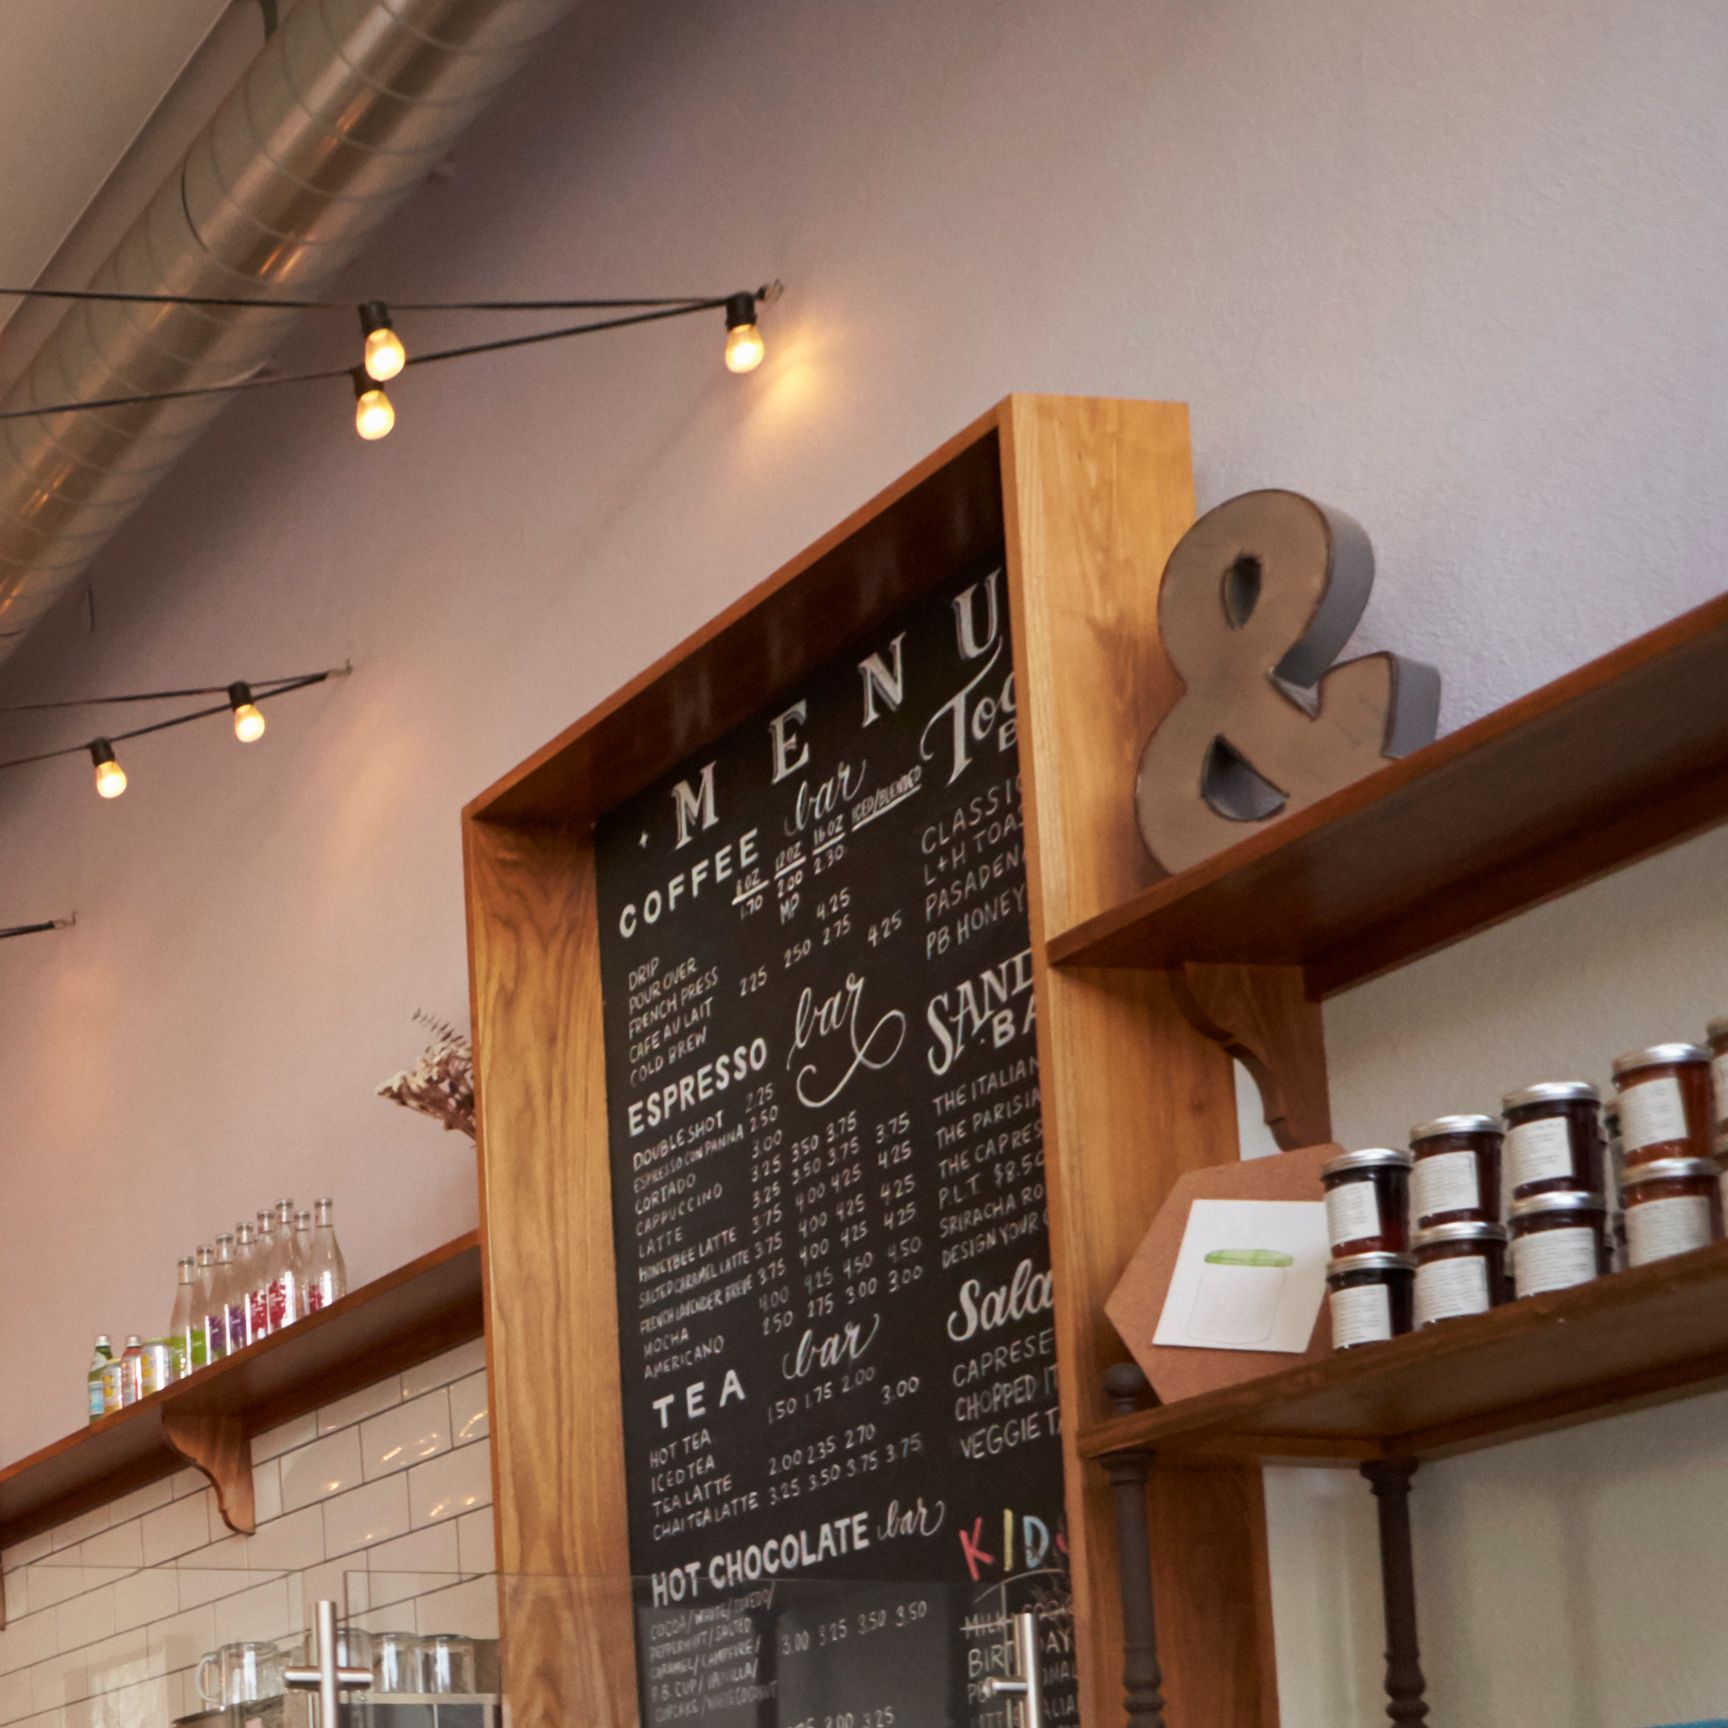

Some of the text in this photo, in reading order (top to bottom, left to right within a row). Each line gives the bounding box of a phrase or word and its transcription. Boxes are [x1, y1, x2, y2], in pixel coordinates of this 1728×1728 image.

[671, 568, 1003, 850] MENU
[619, 759, 866, 938] COFFEE bar
[926, 844, 1025, 921] PASADEN
[958, 884, 1025, 945] HONEY
[629, 957, 659, 991] DRIP
[629, 981, 661, 1015] POUR
[663, 957, 698, 991] OVER
[629, 992, 677, 1040] FRENCH
[681, 966, 718, 1006] PRESS
[629, 1030, 660, 1064] CAFE
[664, 1016, 681, 1040] AU
[684, 997, 713, 1027] LAIT
[628, 972, 905, 1137] ESPRESSO bar
[630, 1056, 664, 1087] COLD
[669, 1026, 706, 1064] BREW
[933, 1084, 966, 1116] THE
[633, 1129, 685, 1171] DOUBLE
[687, 1110, 724, 1143] SHOT
[936, 1120, 966, 1150] THE
[634, 1157, 684, 1193] ESPRESSO
[939, 1150, 969, 1180] THE
[635, 1173, 696, 1215] CORTADO
[636, 1183, 723, 1236] CAPPUCCINO
[940, 1193, 1016, 1238] SRIRACHA
[638, 1226, 683, 1258] LATTE
[699, 1227, 736, 1257] LATTE
[720, 1250, 750, 1275] LATTE
[942, 1212, 1038, 1269] DESIGN YOUR
[644, 1327, 689, 1357] MOCHA
[644, 1335, 724, 1379] AMERICANO
[953, 1329, 1054, 1387] CAPRESE
[652, 1313, 880, 1429] TEA bar
[955, 1375, 1037, 1421] CHOPPED
[650, 1442, 677, 1468] HOT
[682, 1428, 711, 1455] TEA
[960, 1413, 1041, 1459] VEGGIE
[651, 1469, 685, 1494] ICED
[688, 1454, 716, 1480] TEA
[652, 1494, 682, 1517] TEA
[685, 1474, 732, 1505] LATTE
[653, 1517, 685, 1541] CHAI
[687, 1507, 712, 1529] TEA
[714, 1492, 759, 1522] LATTE
[651, 1497, 944, 1608] HOT CHOCOLATE bar
[960, 1508, 1068, 1581] KID
